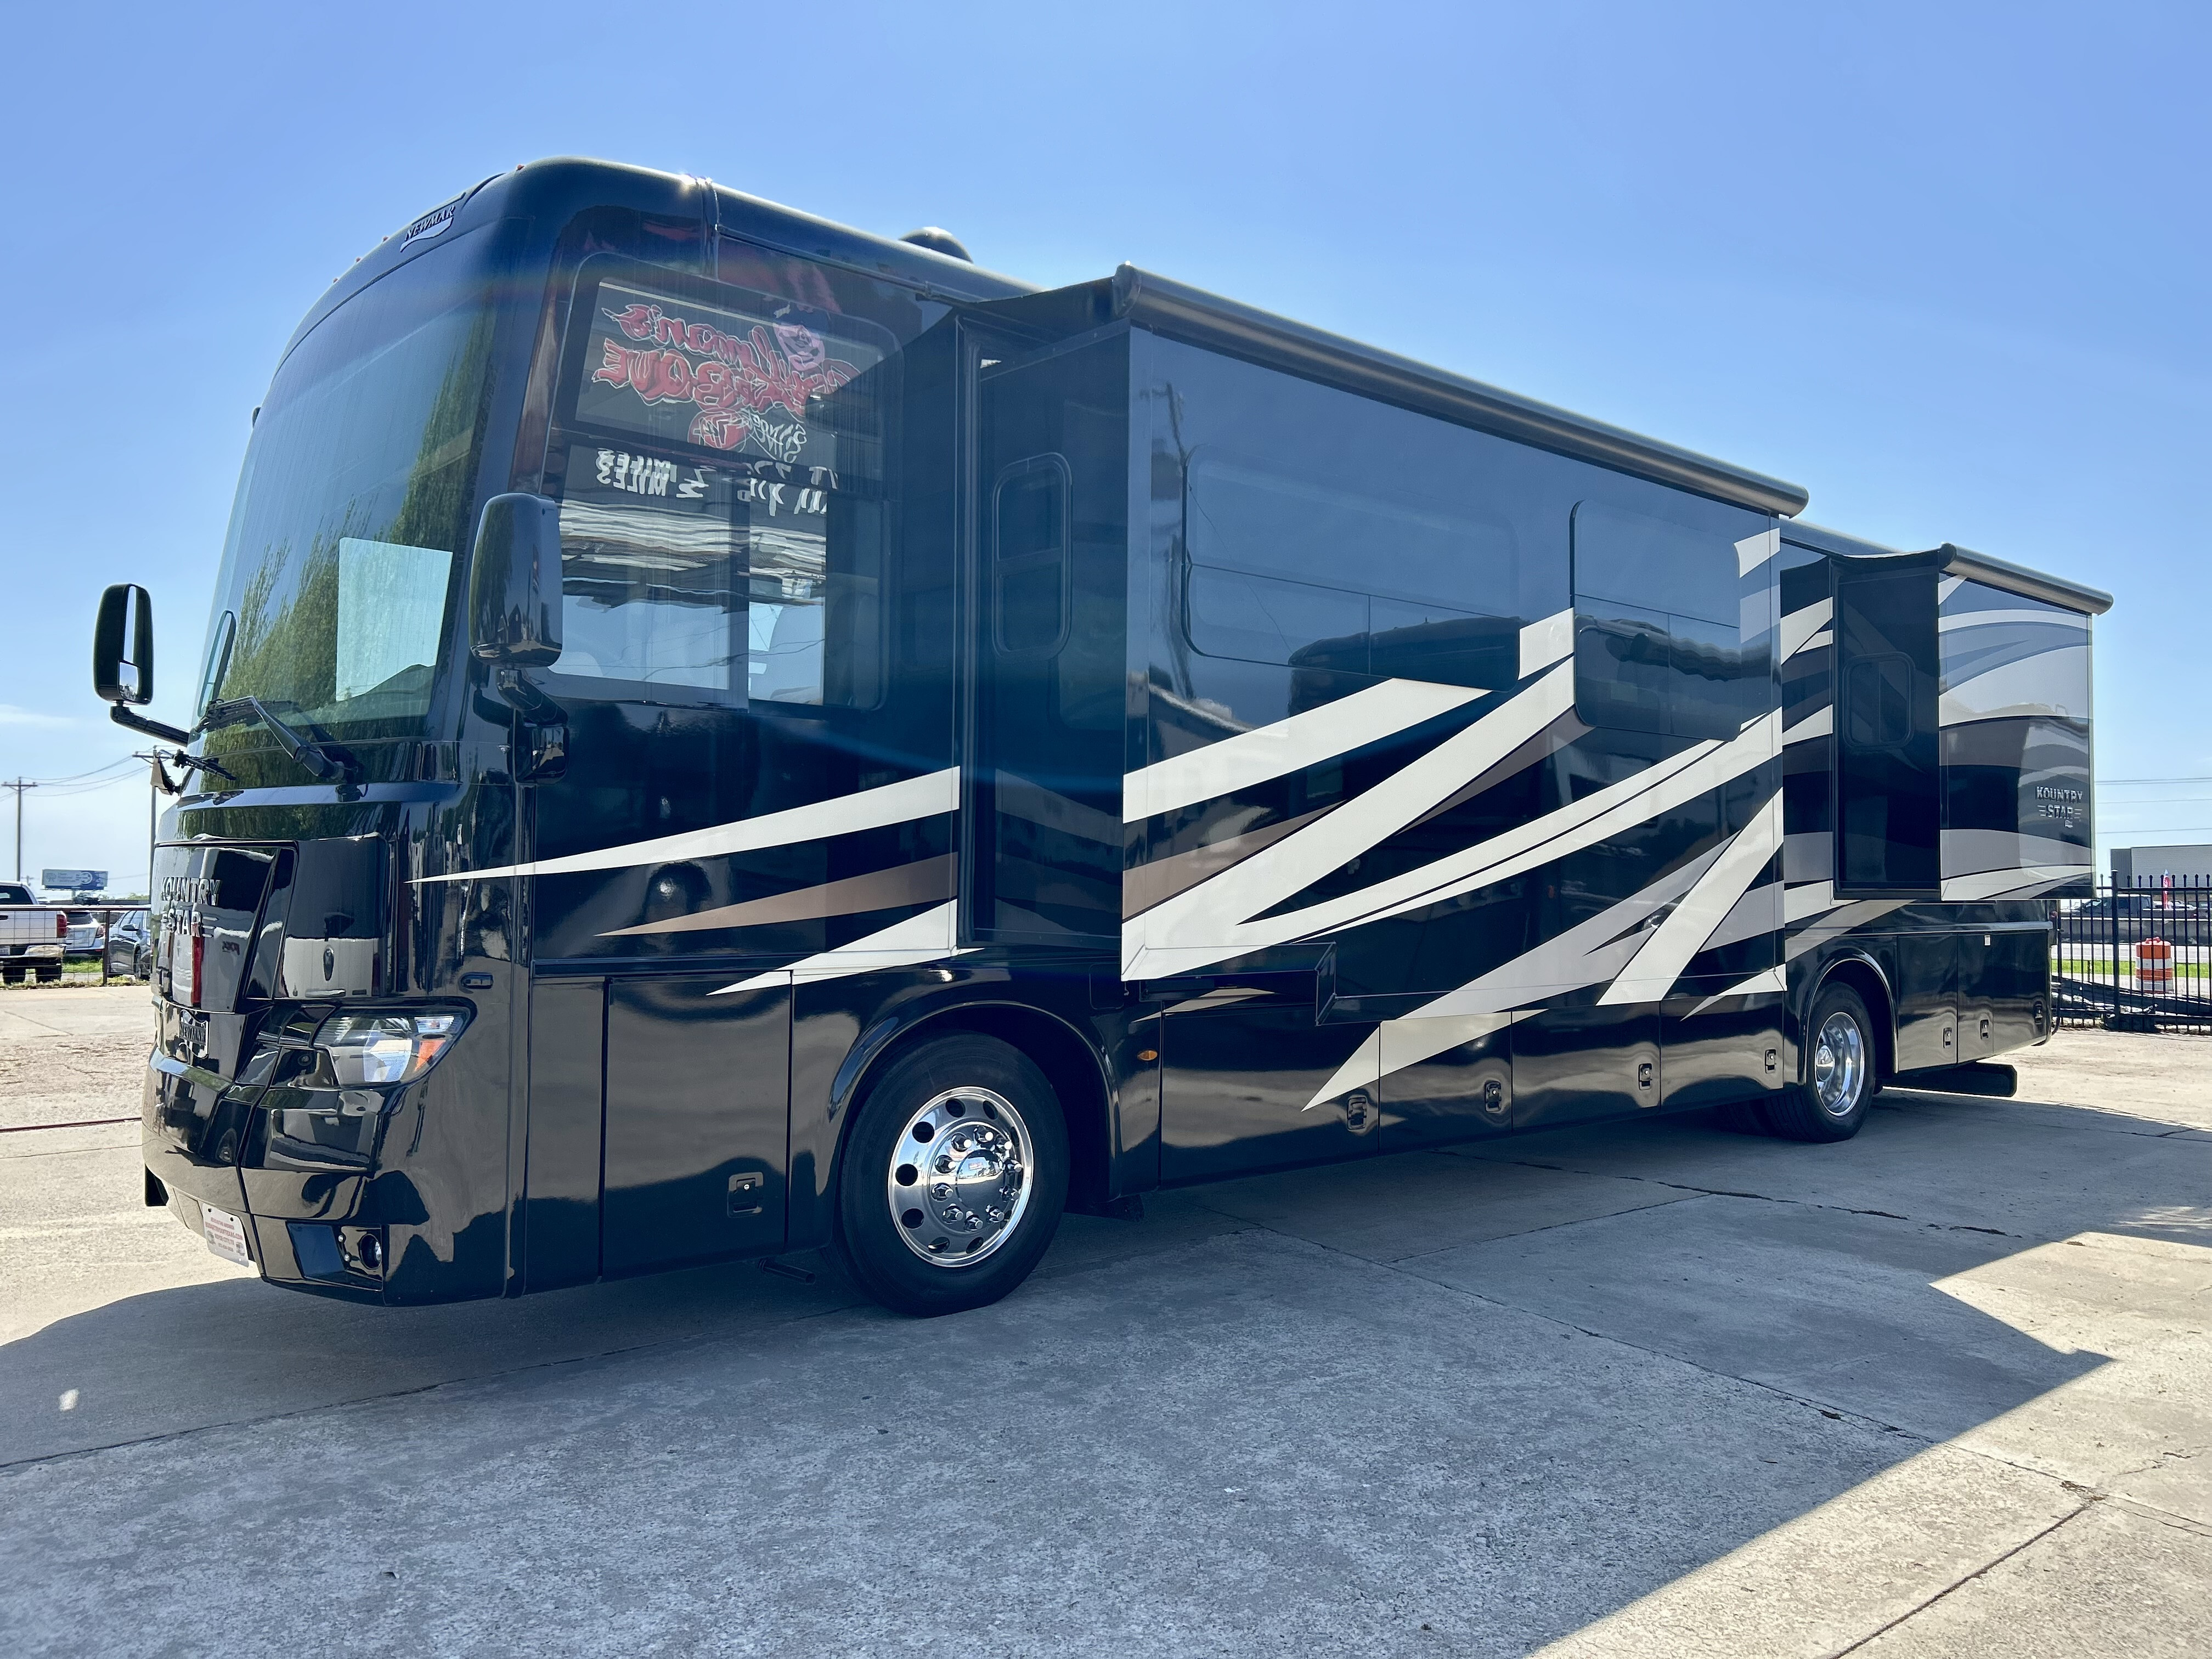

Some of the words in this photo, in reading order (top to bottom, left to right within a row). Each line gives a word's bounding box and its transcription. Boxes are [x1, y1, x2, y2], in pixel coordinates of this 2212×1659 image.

[404, 205, 455, 242] NEWMAR
[2036, 786, 2083, 802] KOUNTRY
[2046, 804, 2074, 820] STAR
[167, 908, 202, 938] STAR
